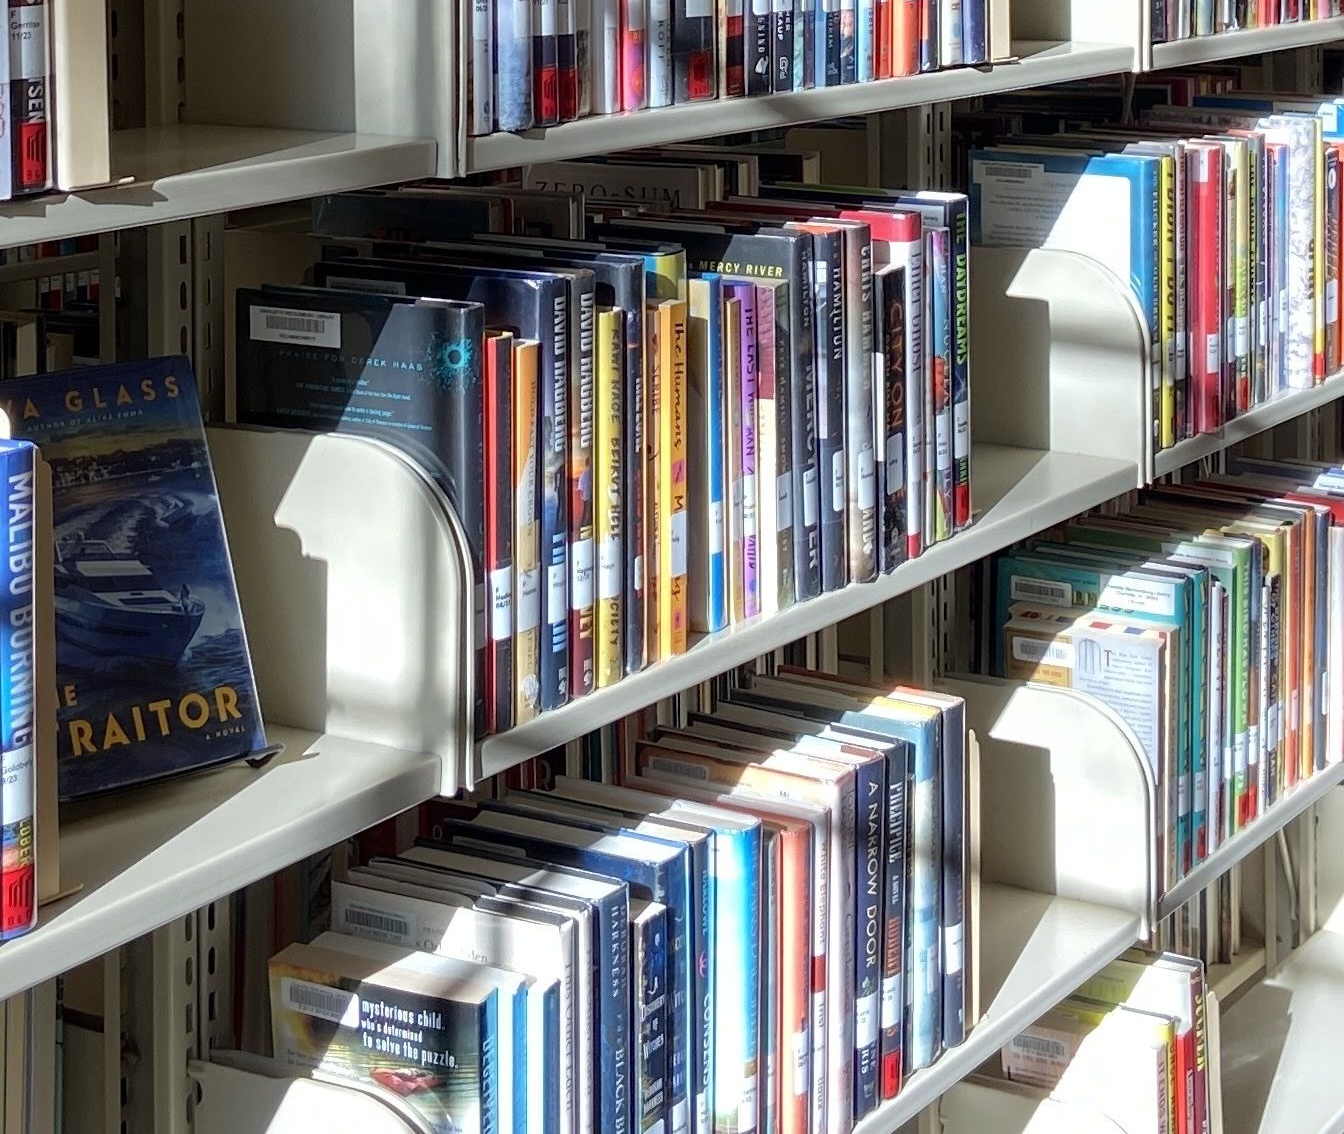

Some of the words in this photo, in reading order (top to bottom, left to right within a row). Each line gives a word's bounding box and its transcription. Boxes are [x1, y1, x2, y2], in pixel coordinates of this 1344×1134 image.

[699, 260, 742, 274] MERCY
[746, 265, 783, 278] RIVER
[580, 292, 594, 353] DAVID
[64, 375, 181, 412] GLASS
[554, 361, 567, 454] HAGBERG
[580, 357, 593, 449] HAGBERG
[674, 362, 684, 450] Humans
[8, 470, 34, 597] MALIBU
[9, 608, 34, 746] BURNING
[58, 686, 244, 759] RAITOR
[865, 803, 879, 895] NARROW
[610, 904, 620, 999] HARKNESS
[865, 905, 878, 969] DOOR
[361, 999, 414, 1024] mysterious
[383, 1022, 423, 1043] determined
[375, 1036, 400, 1055] solve
[403, 1042, 418, 1060] the
[421, 1050, 459, 1069] puzzle.
